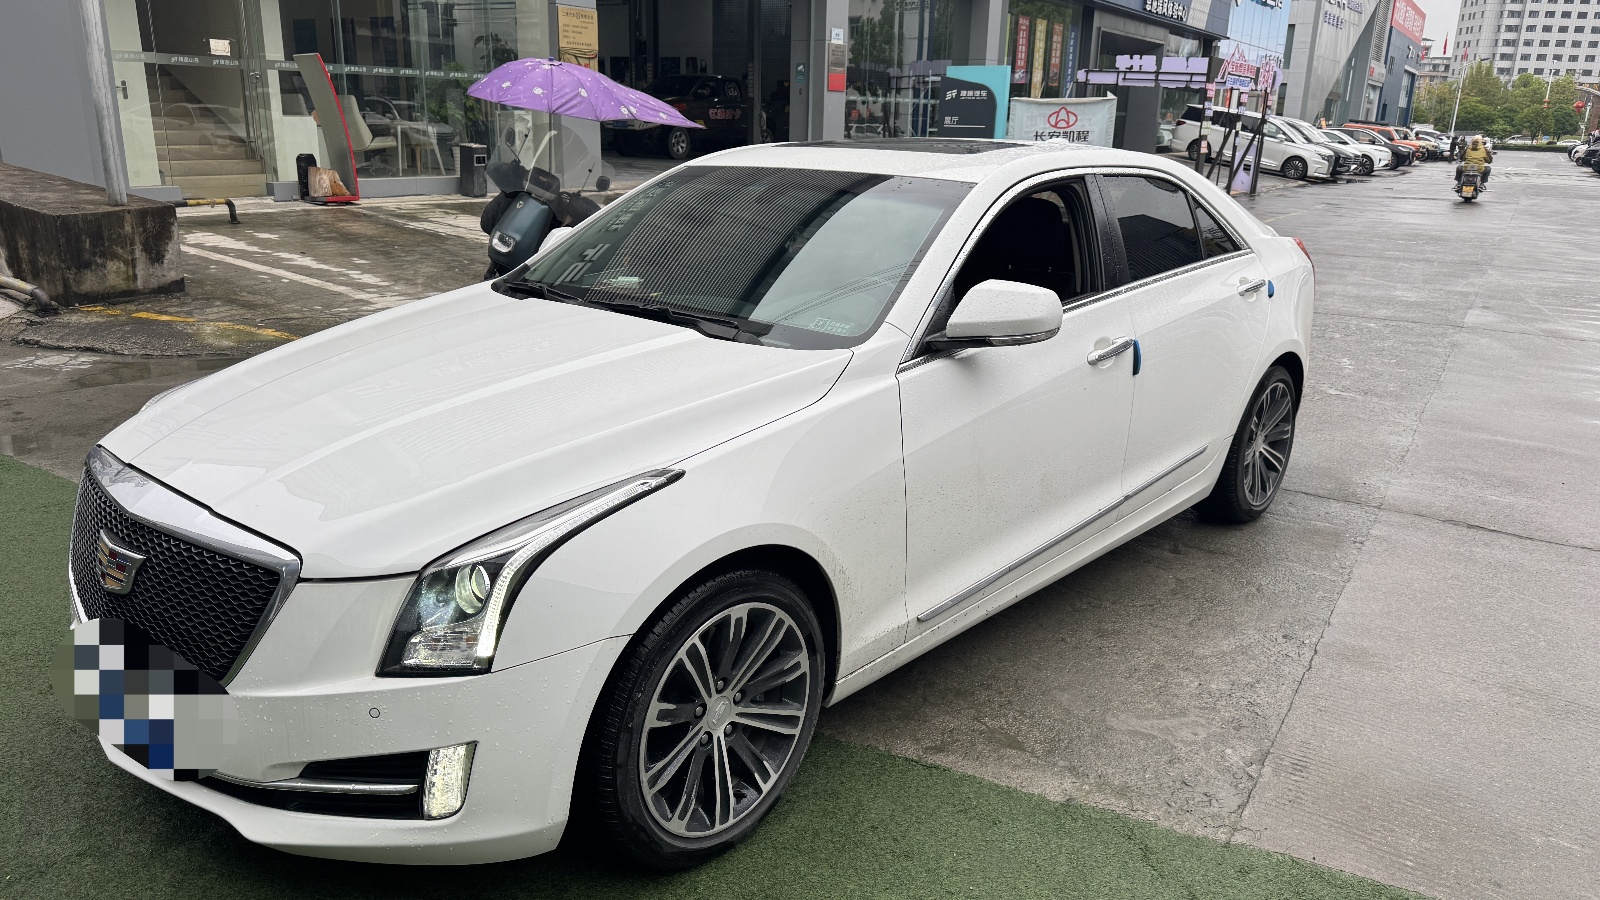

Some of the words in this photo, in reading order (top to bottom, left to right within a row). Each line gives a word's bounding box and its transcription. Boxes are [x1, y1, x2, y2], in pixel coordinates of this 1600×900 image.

[943, 116, 959, 125] 展厅
[1033, 130, 1090, 142] 长安凯程
